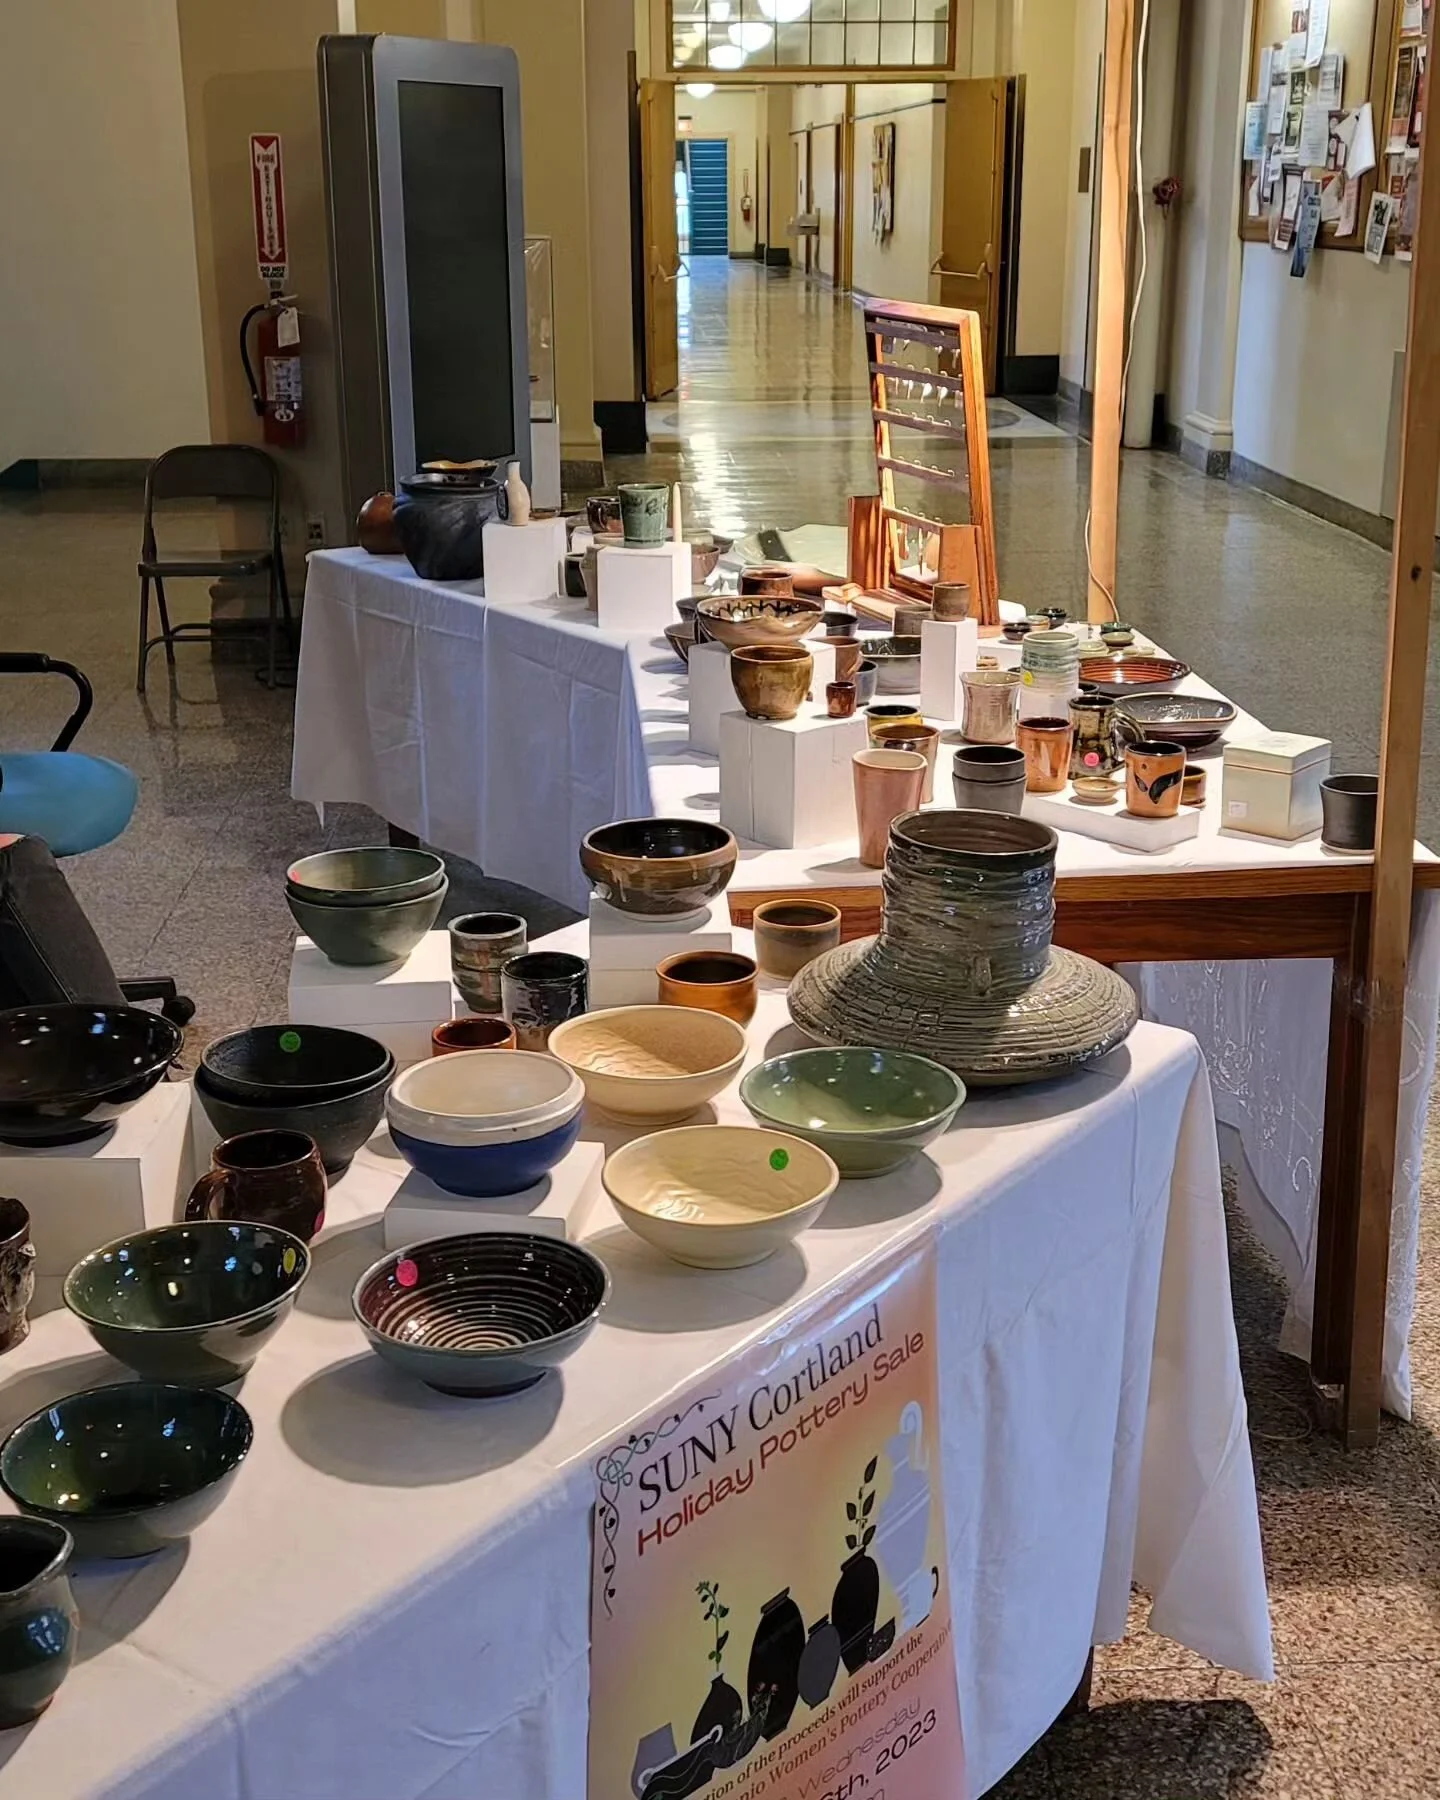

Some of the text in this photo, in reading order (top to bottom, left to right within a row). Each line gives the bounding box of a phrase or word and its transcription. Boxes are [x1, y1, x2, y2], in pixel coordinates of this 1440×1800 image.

[256, 153, 275, 164] FIRE
[637, 1331, 924, 1556] Holiday Pottery Sale
[638, 1303, 884, 1515] SUNY Cortland
[702, 1633, 923, 1800] tion of the proceeds will support the
[768, 1727, 837, 1785] Women's
[840, 1690, 888, 1734] Pottery
[798, 1696, 921, 1800] Wednesday
[875, 1708, 937, 1776] 2023
